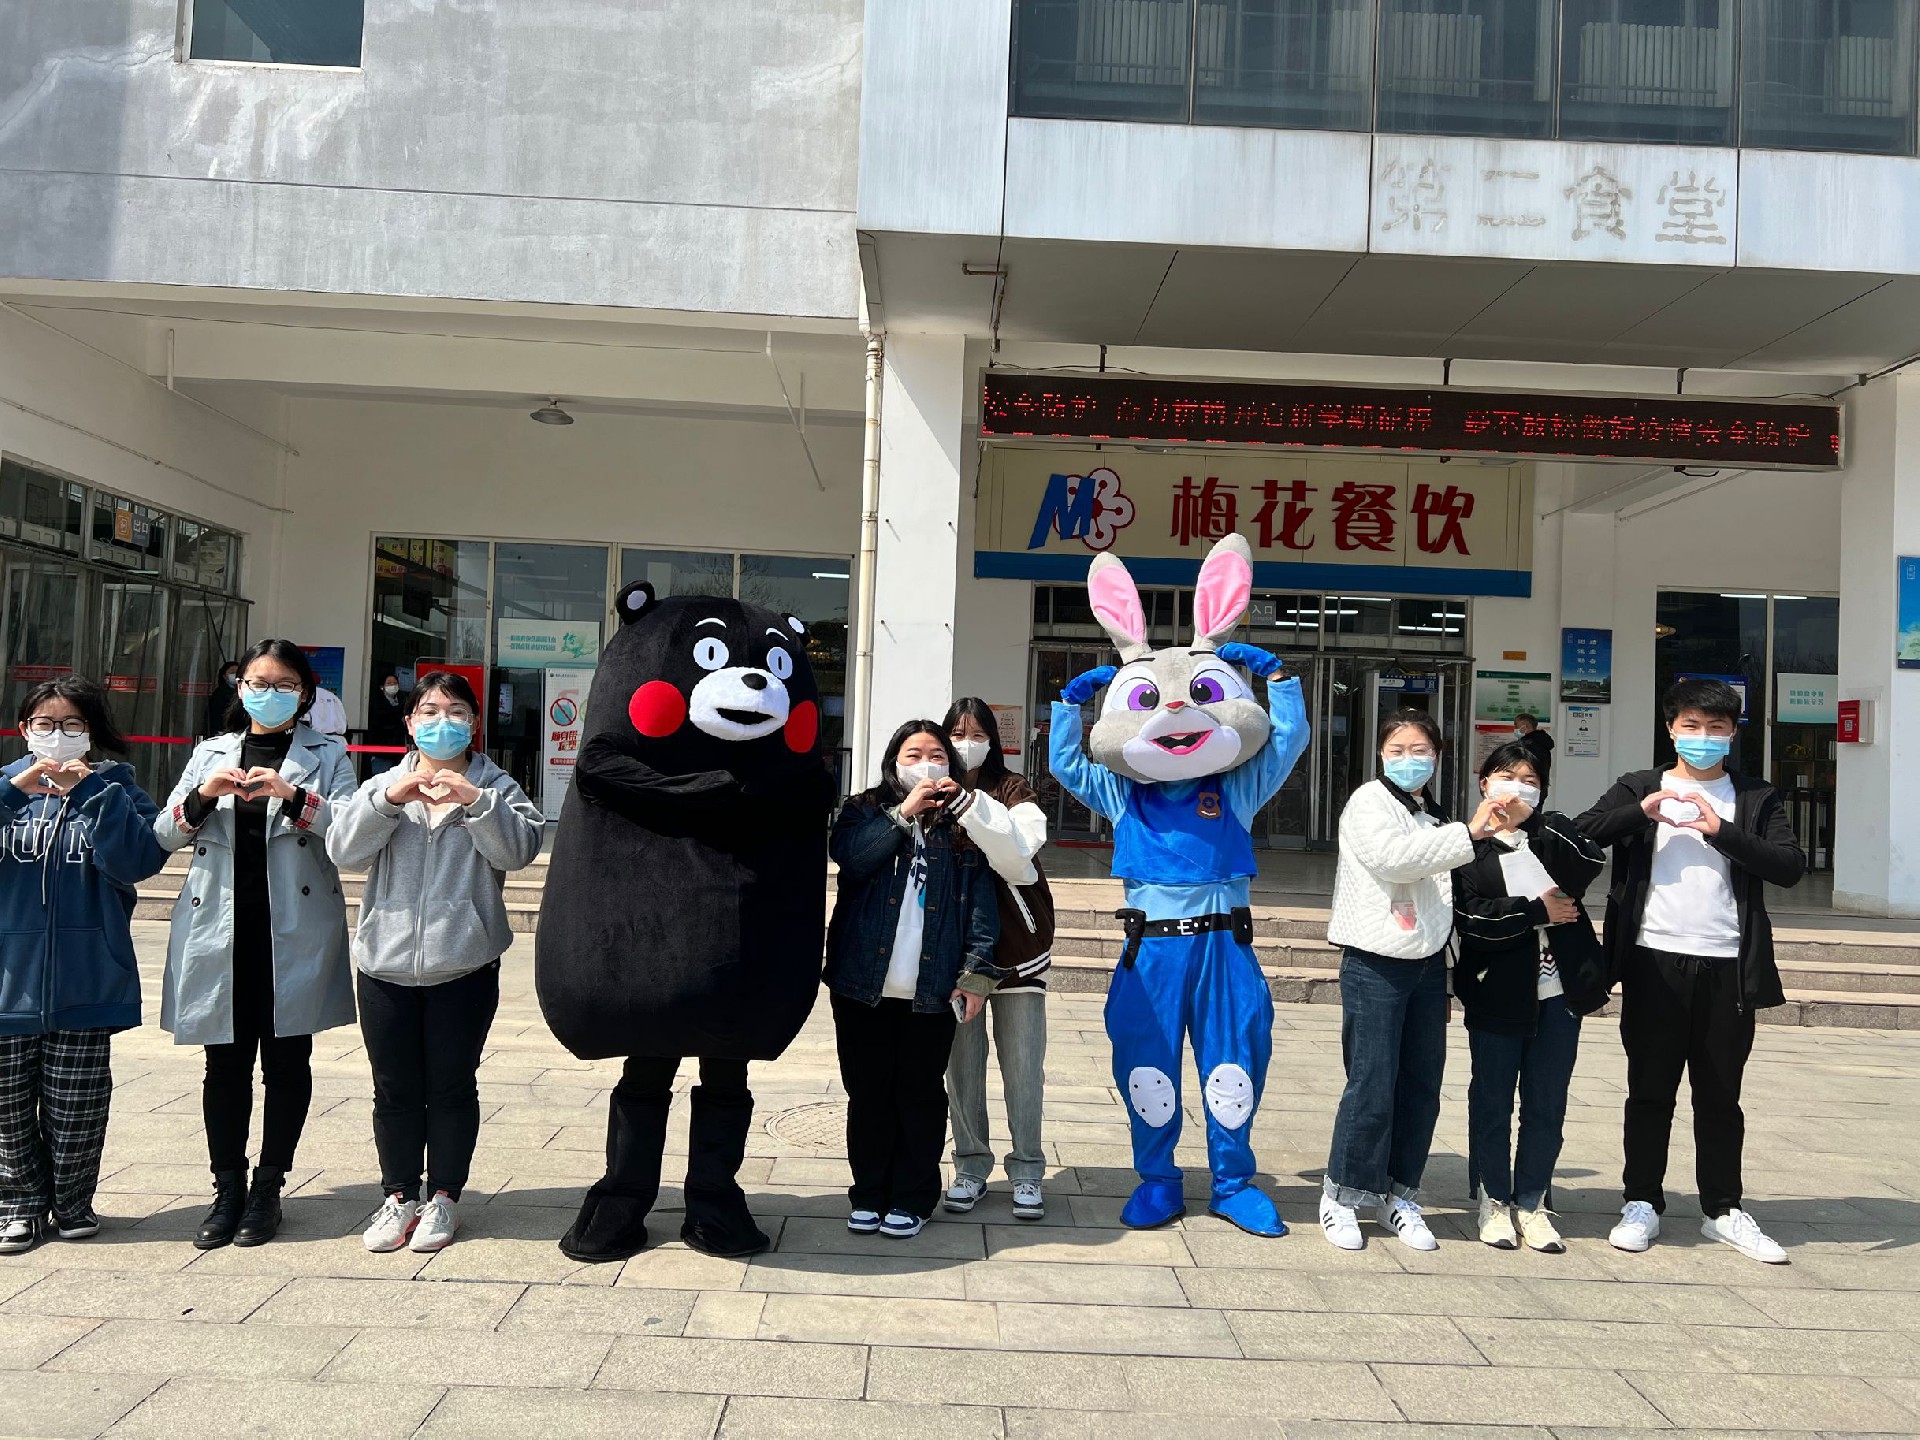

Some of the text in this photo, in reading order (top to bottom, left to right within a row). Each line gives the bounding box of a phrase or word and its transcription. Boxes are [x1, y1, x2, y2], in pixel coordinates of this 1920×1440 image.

[1170, 475, 1476, 557] 梅花餐饮
[1252, 604, 1273, 615] 入口
